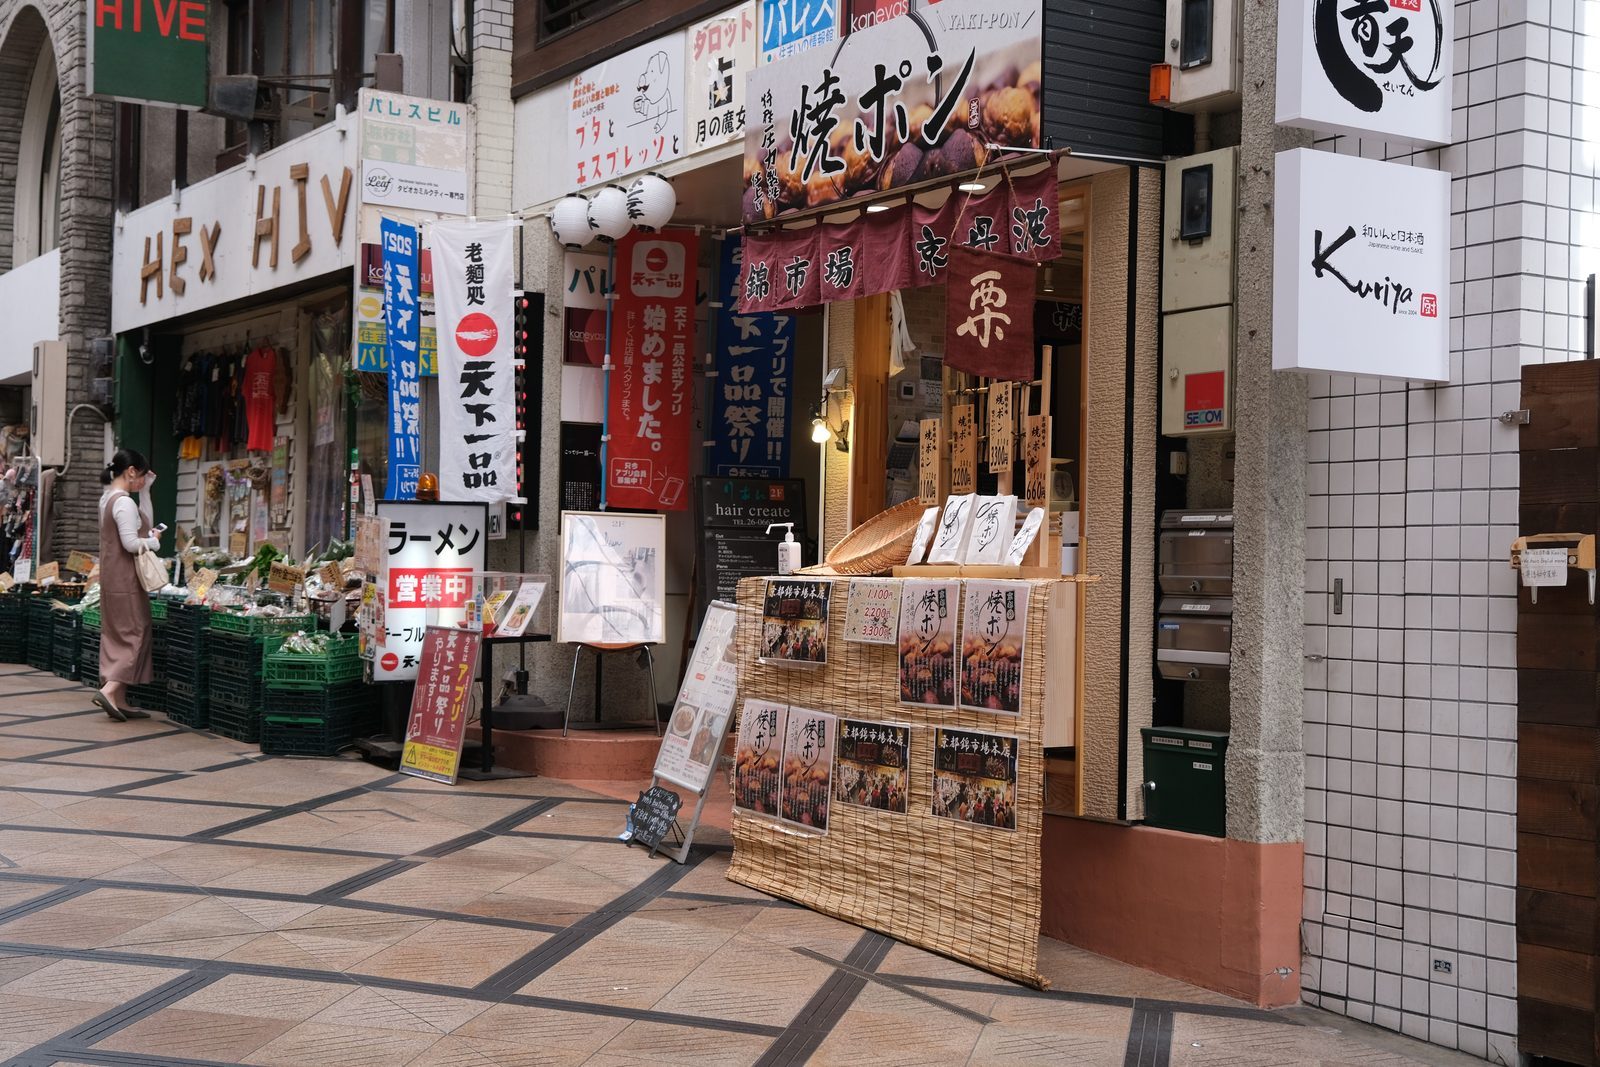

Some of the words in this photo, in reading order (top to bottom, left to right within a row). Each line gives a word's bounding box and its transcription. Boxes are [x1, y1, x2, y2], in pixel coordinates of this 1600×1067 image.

[95, 0, 206, 41] HIVE
[693, 10, 753, 62] タロット
[949, 12, 1021, 31] YAKI-PON
[1382, 80, 1415, 97] せいてん
[368, 97, 461, 126] パレスビル
[696, 104, 746, 144] 月の魔女
[789, 46, 976, 183] 焼ポン
[575, 115, 615, 149] ブタと
[365, 175, 394, 193] Leaf
[397, 184, 465, 201] タピオカミルクティー専門店
[252, 162, 353, 269] HIV
[1361, 223, 1424, 246] 和いんと日本酒
[1368, 241, 1390, 250] Japanese
[140, 217, 222, 305] HEX
[745, 246, 853, 302] 錦市場
[1311, 224, 1413, 315] Kuriya
[632, 271, 683, 289] 天下一品
[956, 270, 1012, 348] 栗
[671, 305, 688, 416] 天下一品公式アプリ
[636, 304, 668, 452] 始めました。
[460, 361, 498, 489] 天下一品
[995, 393, 1005, 433] 焼ポン
[1186, 410, 1222, 425] SECOM
[924, 428, 932, 467] 焼ポン
[958, 415, 967, 453] 焼ポン
[615, 469, 647, 478] アプリ会員
[770, 488, 783, 498] 2F
[715, 503, 744, 516] hair
[748, 506, 791, 518] create
[388, 522, 480, 556] ラーメン
[395, 573, 467, 603] 営業中
[768, 584, 827, 599] 京都錦市場本店
[842, 726, 906, 747] 京都錦市場本店
[940, 734, 1013, 758] 京都錦市場本店
